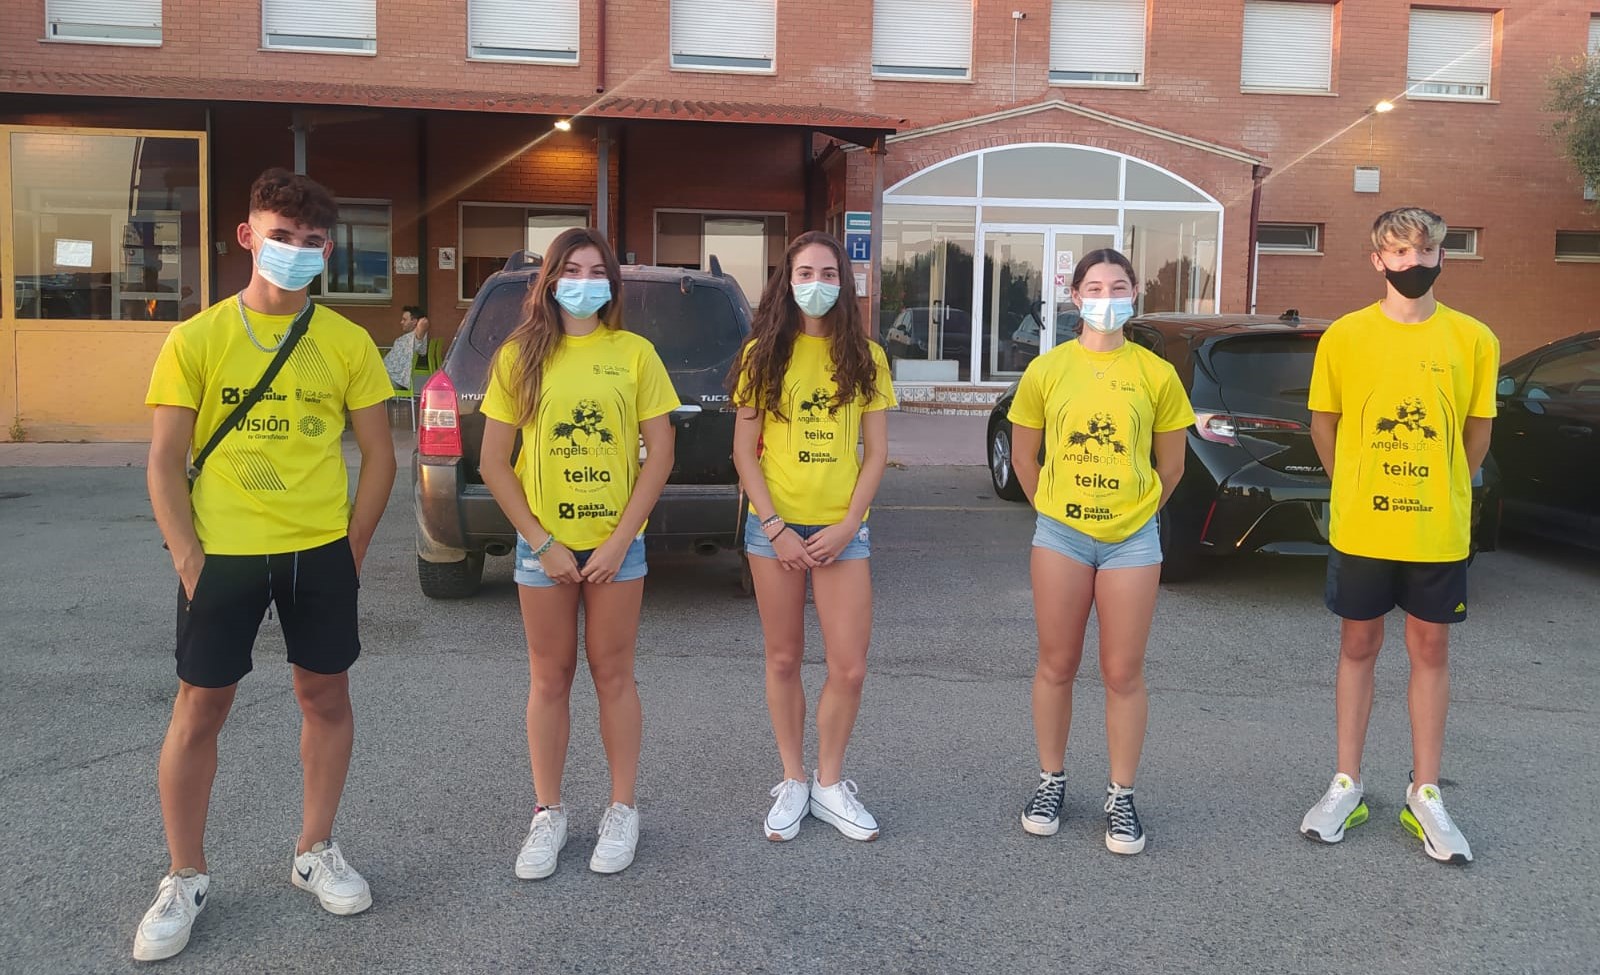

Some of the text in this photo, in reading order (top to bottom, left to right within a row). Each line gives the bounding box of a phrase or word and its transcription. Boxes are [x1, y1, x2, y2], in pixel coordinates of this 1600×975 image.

[853, 242, 867, 258] H
[804, 429, 834, 440] teika
[563, 466, 611, 483] teika
[1382, 461, 1429, 478] teika
[1074, 473, 1120, 490] teika
[577, 503, 605, 511] caixa
[1083, 506, 1110, 514] caixa
[1391, 504, 1434, 513] popular
[577, 509, 618, 519] popular
